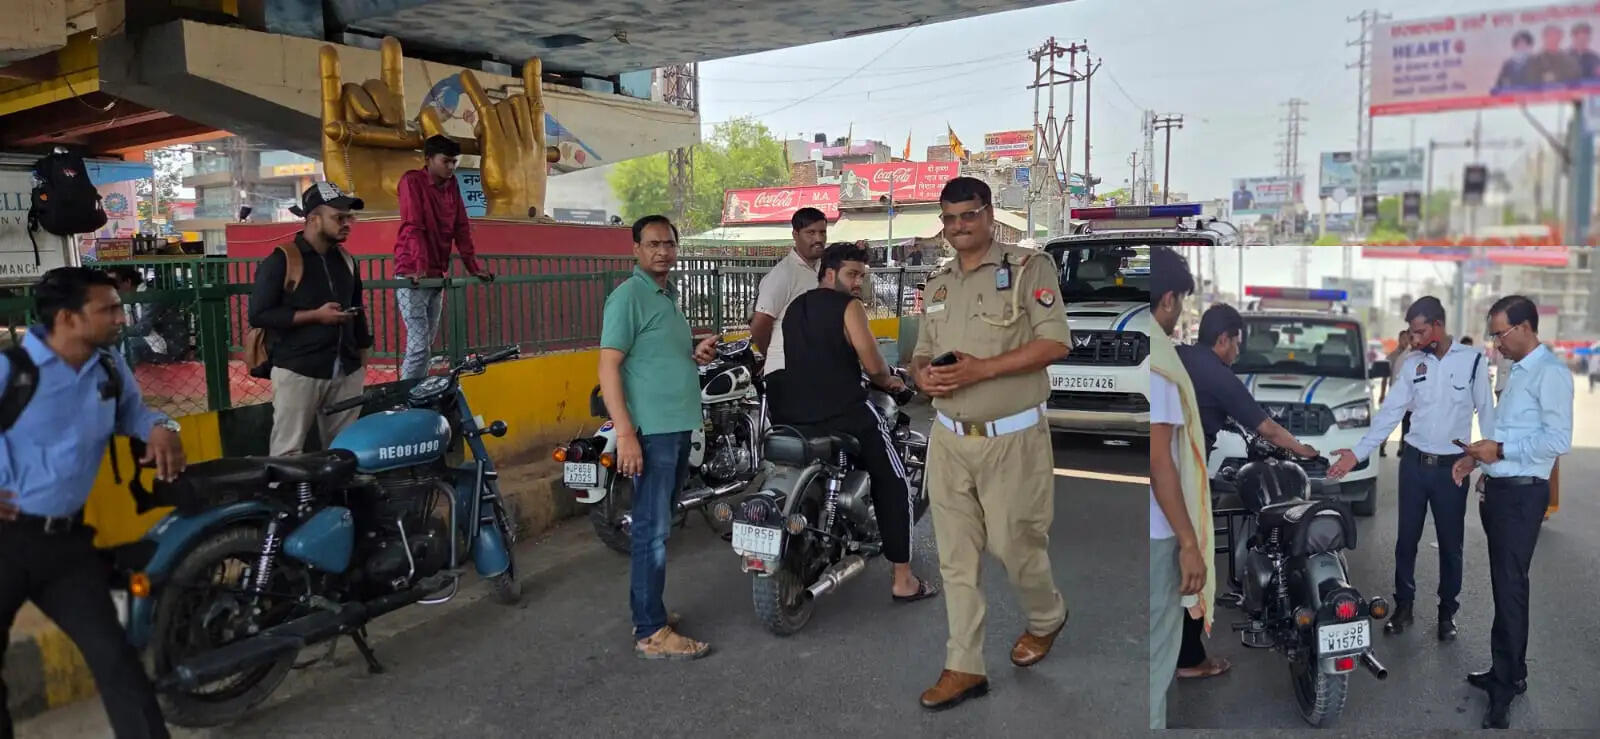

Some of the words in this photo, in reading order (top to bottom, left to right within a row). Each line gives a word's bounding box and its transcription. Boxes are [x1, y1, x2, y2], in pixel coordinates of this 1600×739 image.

[1393, 40, 1450, 59] HEART
[873, 166, 914, 184] Coca-Cola
[753, 190, 794, 208] Coca-Cola
[1052, 375, 1113, 389] UP32EG7426
[741, 525, 775, 541] UP85B
[1328, 635, 1364, 651] W1576
